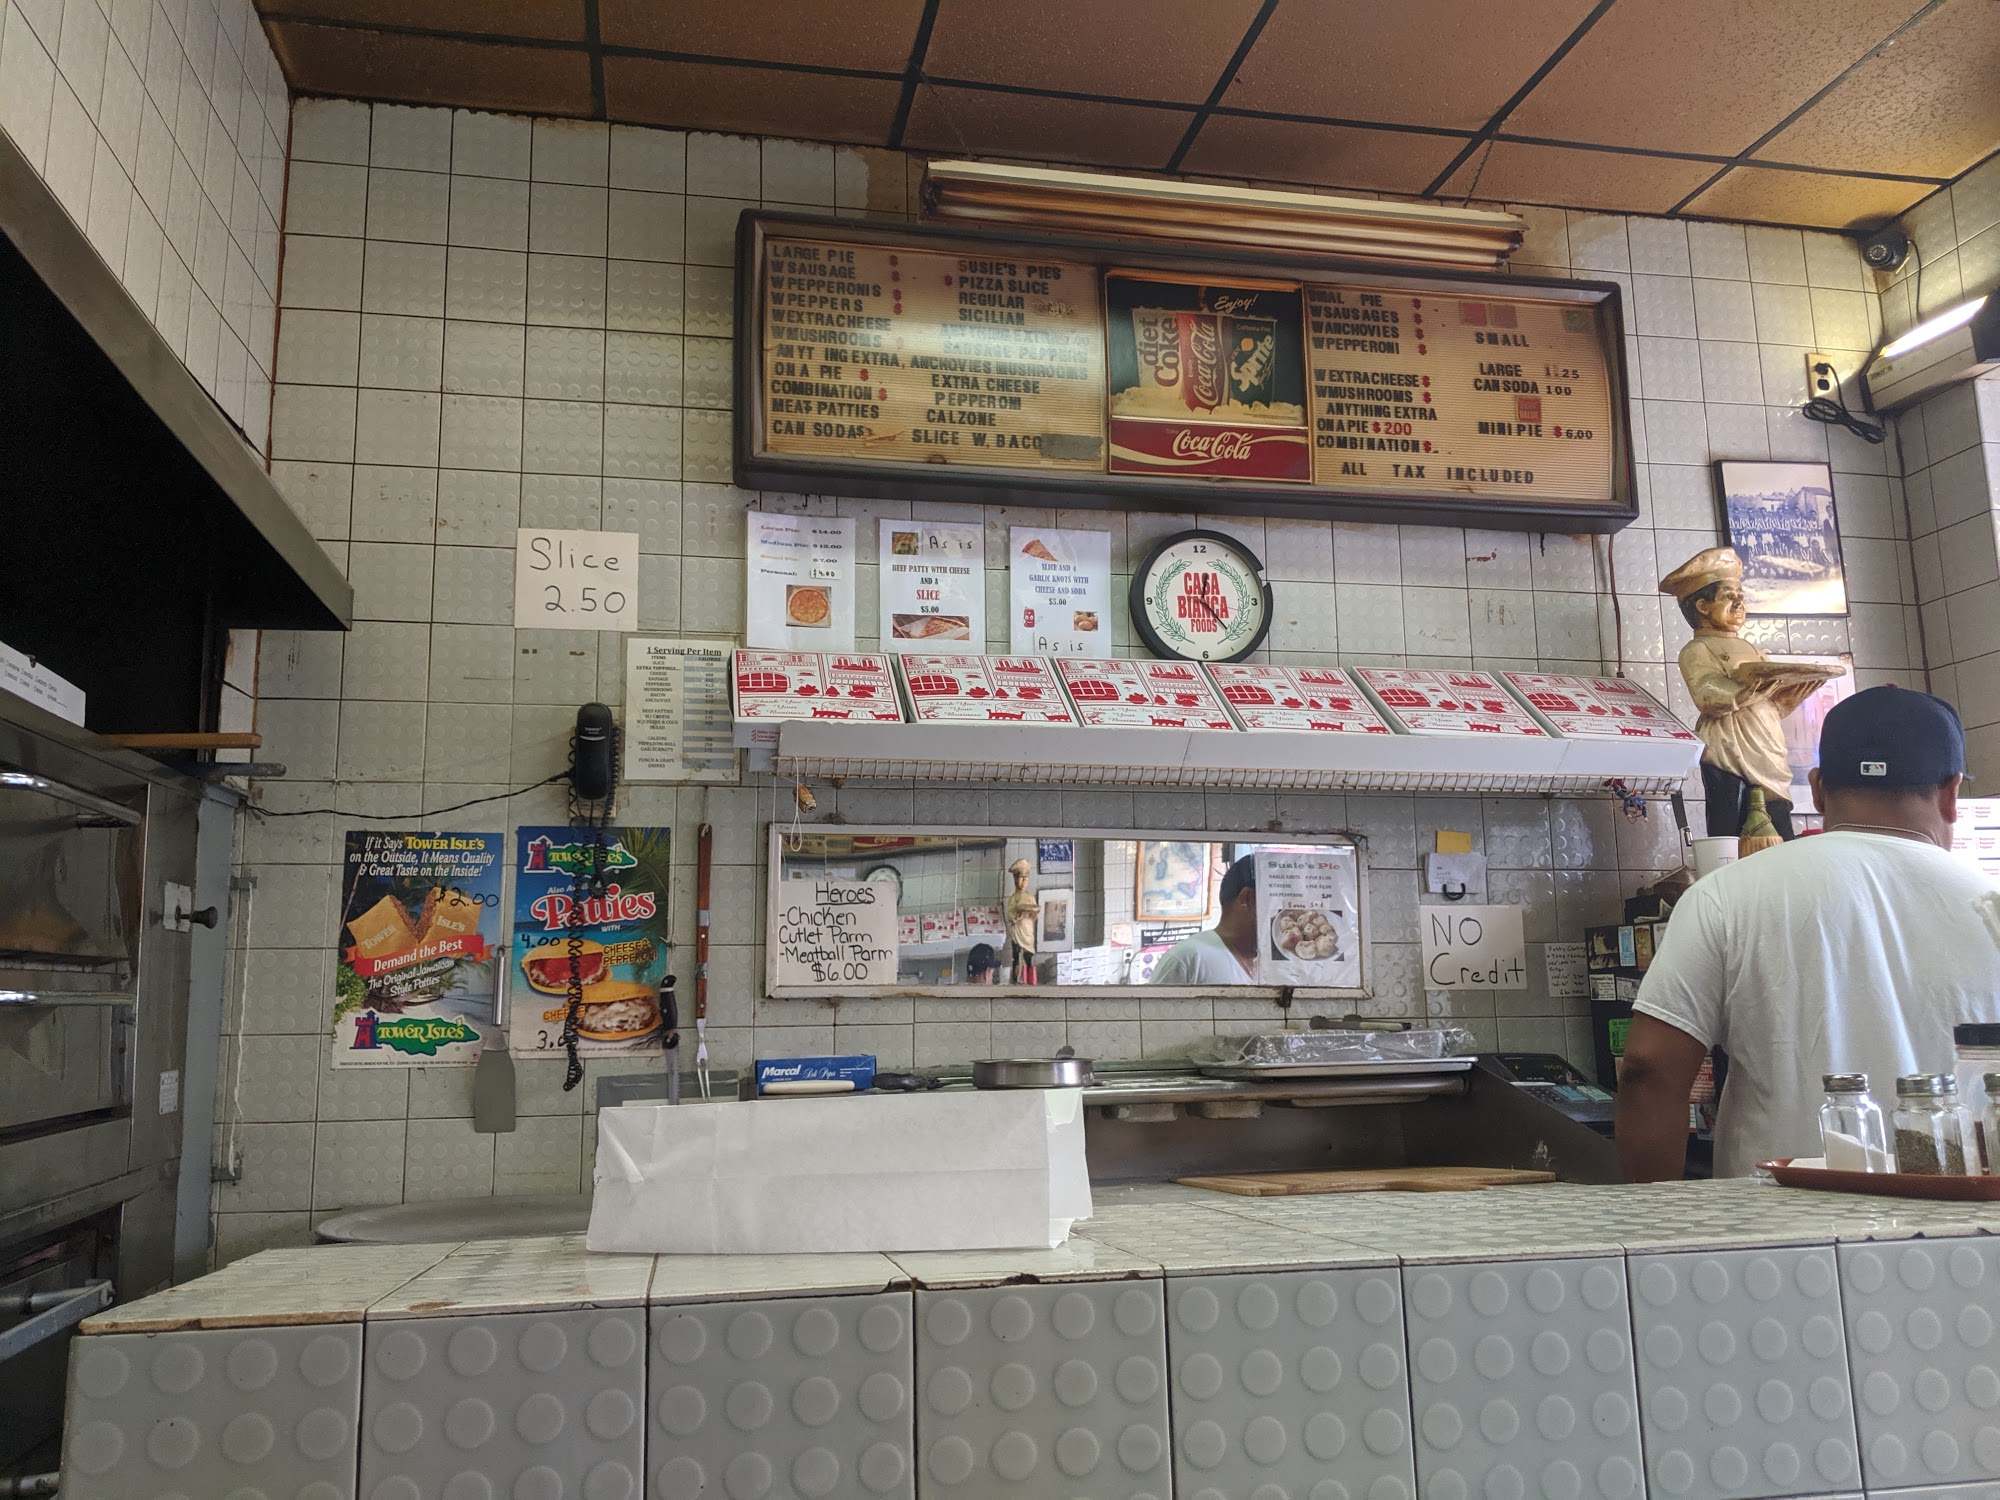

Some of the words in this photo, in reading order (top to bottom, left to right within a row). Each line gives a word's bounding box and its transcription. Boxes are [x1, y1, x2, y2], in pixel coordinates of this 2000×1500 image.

[773, 245, 819, 260] LARGE
[828, 250, 854, 264] PIE
[788, 261, 856, 279] SAUSAGE
[1027, 266, 1061, 280] PIES
[959, 276, 1004, 292] PIZZA
[1008, 280, 1049, 295] SLICE
[788, 292, 863, 312] PEPPERS
[959, 292, 1024, 309] REGULAR
[1214, 294, 1259, 313] Enjoy!
[959, 308, 1024, 325] SICILIAN
[1139, 317, 1158, 366] diet
[1475, 332, 1529, 347] SMALL
[1154, 317, 1179, 387] Coke
[775, 362, 795, 376] ON
[800, 364, 809, 377] A
[820, 365, 842, 379] PIE
[1231, 335, 1274, 392] Sprite
[1480, 363, 1522, 377] LARGE
[772, 380, 872, 400] COMBINATION
[932, 374, 980, 390] EXTRA
[986, 378, 1040, 394] CHEESE
[1474, 379, 1500, 392] CAN
[1503, 380, 1539, 394] SODA
[818, 401, 880, 418] PATTIES
[935, 392, 1021, 410] PEPPERONI
[927, 409, 996, 426] CALZONE
[1326, 402, 1390, 418] ANYTHING
[1395, 407, 1437, 420] EXTRA
[773, 420, 805, 435] CAN
[1317, 418, 1334, 431] ON
[1336, 420, 1344, 431] A
[1348, 420, 1368, 433] PIE
[1478, 422, 1512, 435] MINI
[1517, 424, 1542, 437] PIE
[912, 429, 959, 445] SLICE
[1173, 429, 1253, 459] Coca-Cola
[1316, 435, 1420, 453] COMBINATION
[1342, 462, 1367, 476] ALL
[1392, 464, 1425, 478] TAX
[1446, 467, 1534, 484] INCLUDED
[929, 536, 948, 549] As
[959, 540, 973, 549] is
[530, 537, 619, 570] Slice
[1052, 575, 1071, 583] KNOTS
[1183, 572, 1220, 595] CASA
[545, 585, 625, 613] 2.50
[917, 590, 940, 600] SLICE
[1251, 598, 1258, 606] 3
[1177, 596, 1229, 618] BIANCA
[1191, 619, 1217, 632] FOODS
[654, 647, 685, 656] Serving
[1039, 636, 1059, 651] As
[1070, 640, 1083, 651] is
[1202, 651, 1209, 659] 6
[365, 837, 374, 850] If
[374, 837, 381, 848] it
[383, 837, 403, 851] Says
[406, 836, 448, 850] TOWER
[350, 853, 361, 862] on
[364, 851, 378, 863] the
[381, 851, 418, 865] Outside,
[421, 851, 428, 863] It
[430, 851, 459, 863] Means
[461, 852, 494, 866] Quality
[369, 864, 394, 876] Great
[396, 865, 418, 876] Taste
[420, 868, 432, 876] on
[434, 865, 449, 876] the
[451, 865, 483, 877] Inside!
[436, 885, 499, 907] $2.00
[815, 882, 875, 903] Heroes
[362, 924, 397, 950] TOWER
[778, 925, 823, 944] Cutlet
[829, 926, 872, 944] Parm
[1432, 913, 1482, 946] NO
[521, 934, 560, 948] 4.00
[374, 948, 417, 972] Demand
[420, 944, 435, 958] the
[440, 939, 463, 953] Best
[849, 946, 893, 962] Parm
[368, 978, 382, 990] The
[384, 966, 416, 986] Original
[418, 959, 454, 975] Jamaican
[811, 963, 868, 982] $6.00
[1430, 952, 1524, 985] Credit
[390, 985, 412, 997] Style
[414, 976, 440, 990] Patties
[543, 1006, 585, 1021] CHEEE
[761, 1064, 801, 1079] Marcal
